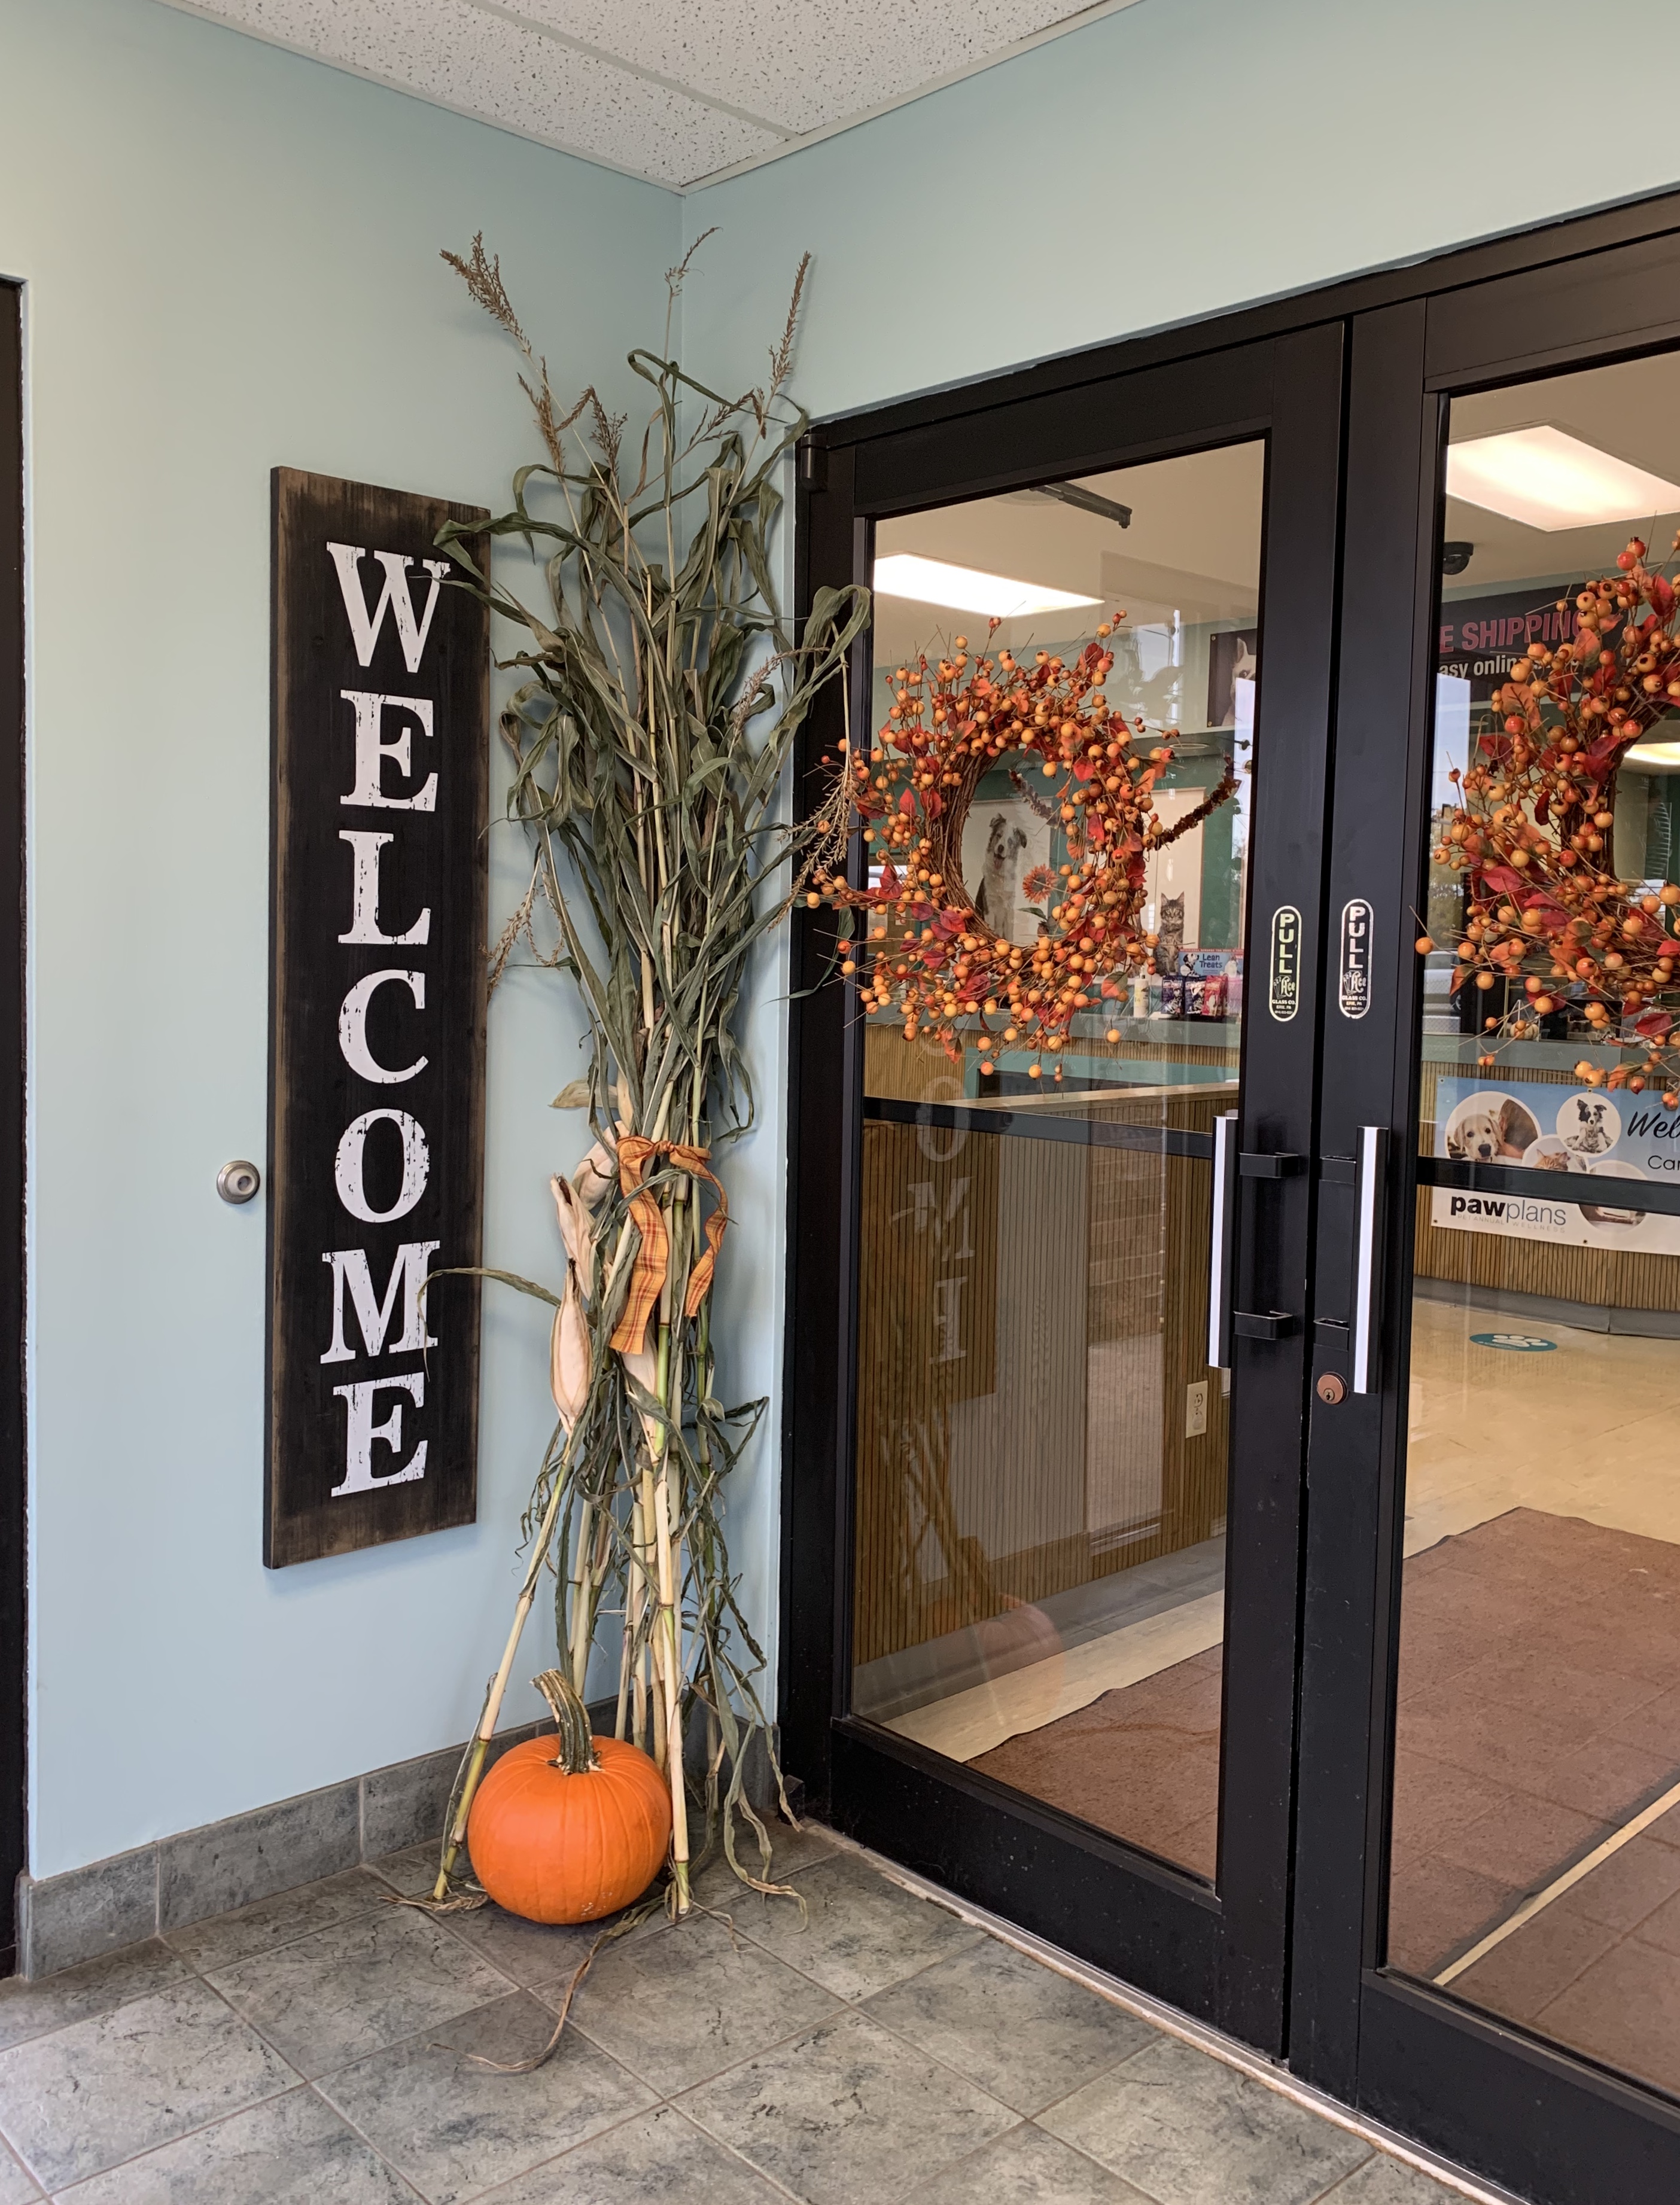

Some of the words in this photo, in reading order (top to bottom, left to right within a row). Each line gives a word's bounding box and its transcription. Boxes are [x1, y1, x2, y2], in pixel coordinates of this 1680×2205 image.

[1474, 655, 1521, 675] onlin
[1279, 913, 1295, 973] PULL
[1349, 906, 1365, 969] PULL
[320, 541, 451, 1499] WELCOME
[1451, 1196, 1566, 1226] pawplans
[1474, 1216, 1505, 1225] ANNUAL
[1512, 1221, 1566, 1234] WELLNESS
